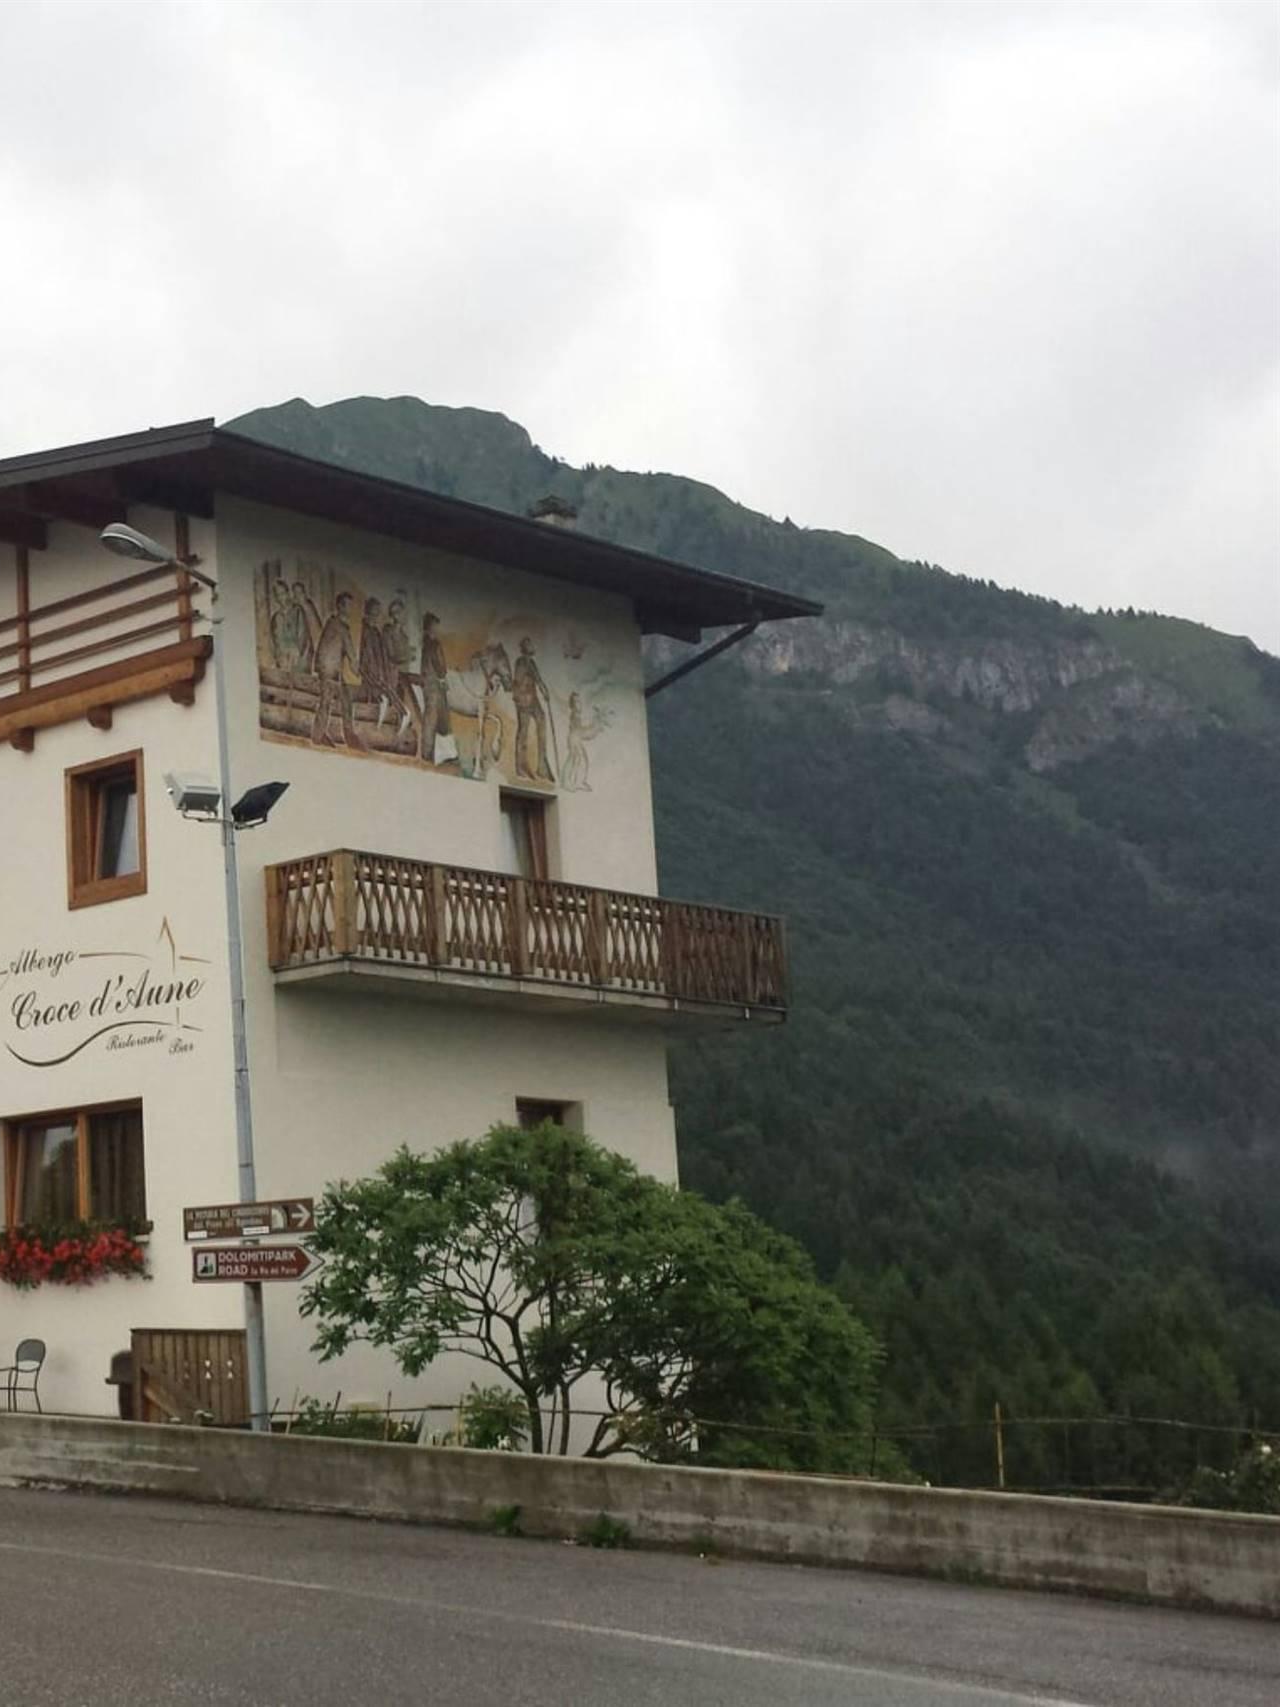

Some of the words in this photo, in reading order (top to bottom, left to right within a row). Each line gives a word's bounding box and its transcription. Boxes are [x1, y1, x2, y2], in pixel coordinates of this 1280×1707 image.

[10, 990, 82, 1030] Croce
[89, 968, 205, 1017] d'Aune
[106, 1029, 166, 1051] Ristorante
[218, 1250, 297, 1263] DOLOMITIPARK
[218, 1264, 249, 1275] ROAD
